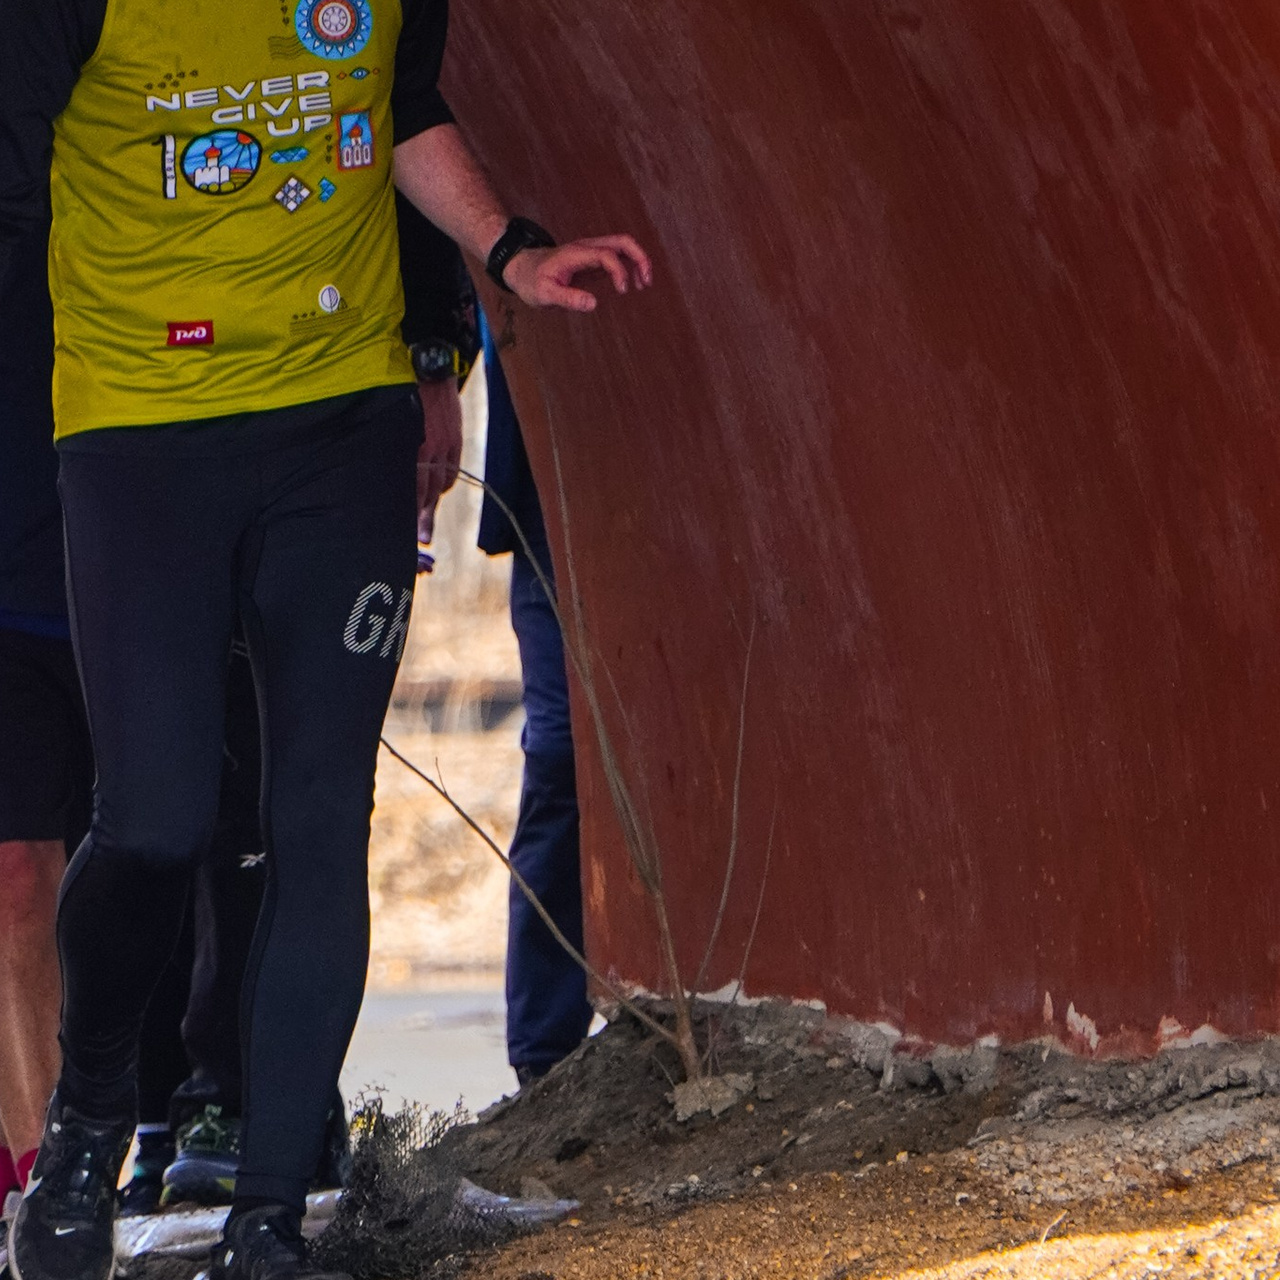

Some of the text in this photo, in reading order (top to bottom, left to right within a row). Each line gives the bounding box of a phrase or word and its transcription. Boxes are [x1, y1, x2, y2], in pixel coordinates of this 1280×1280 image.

[146, 71, 330, 111] NEVER
[211, 92, 332, 124] GIVE
[268, 114, 332, 137] UP
